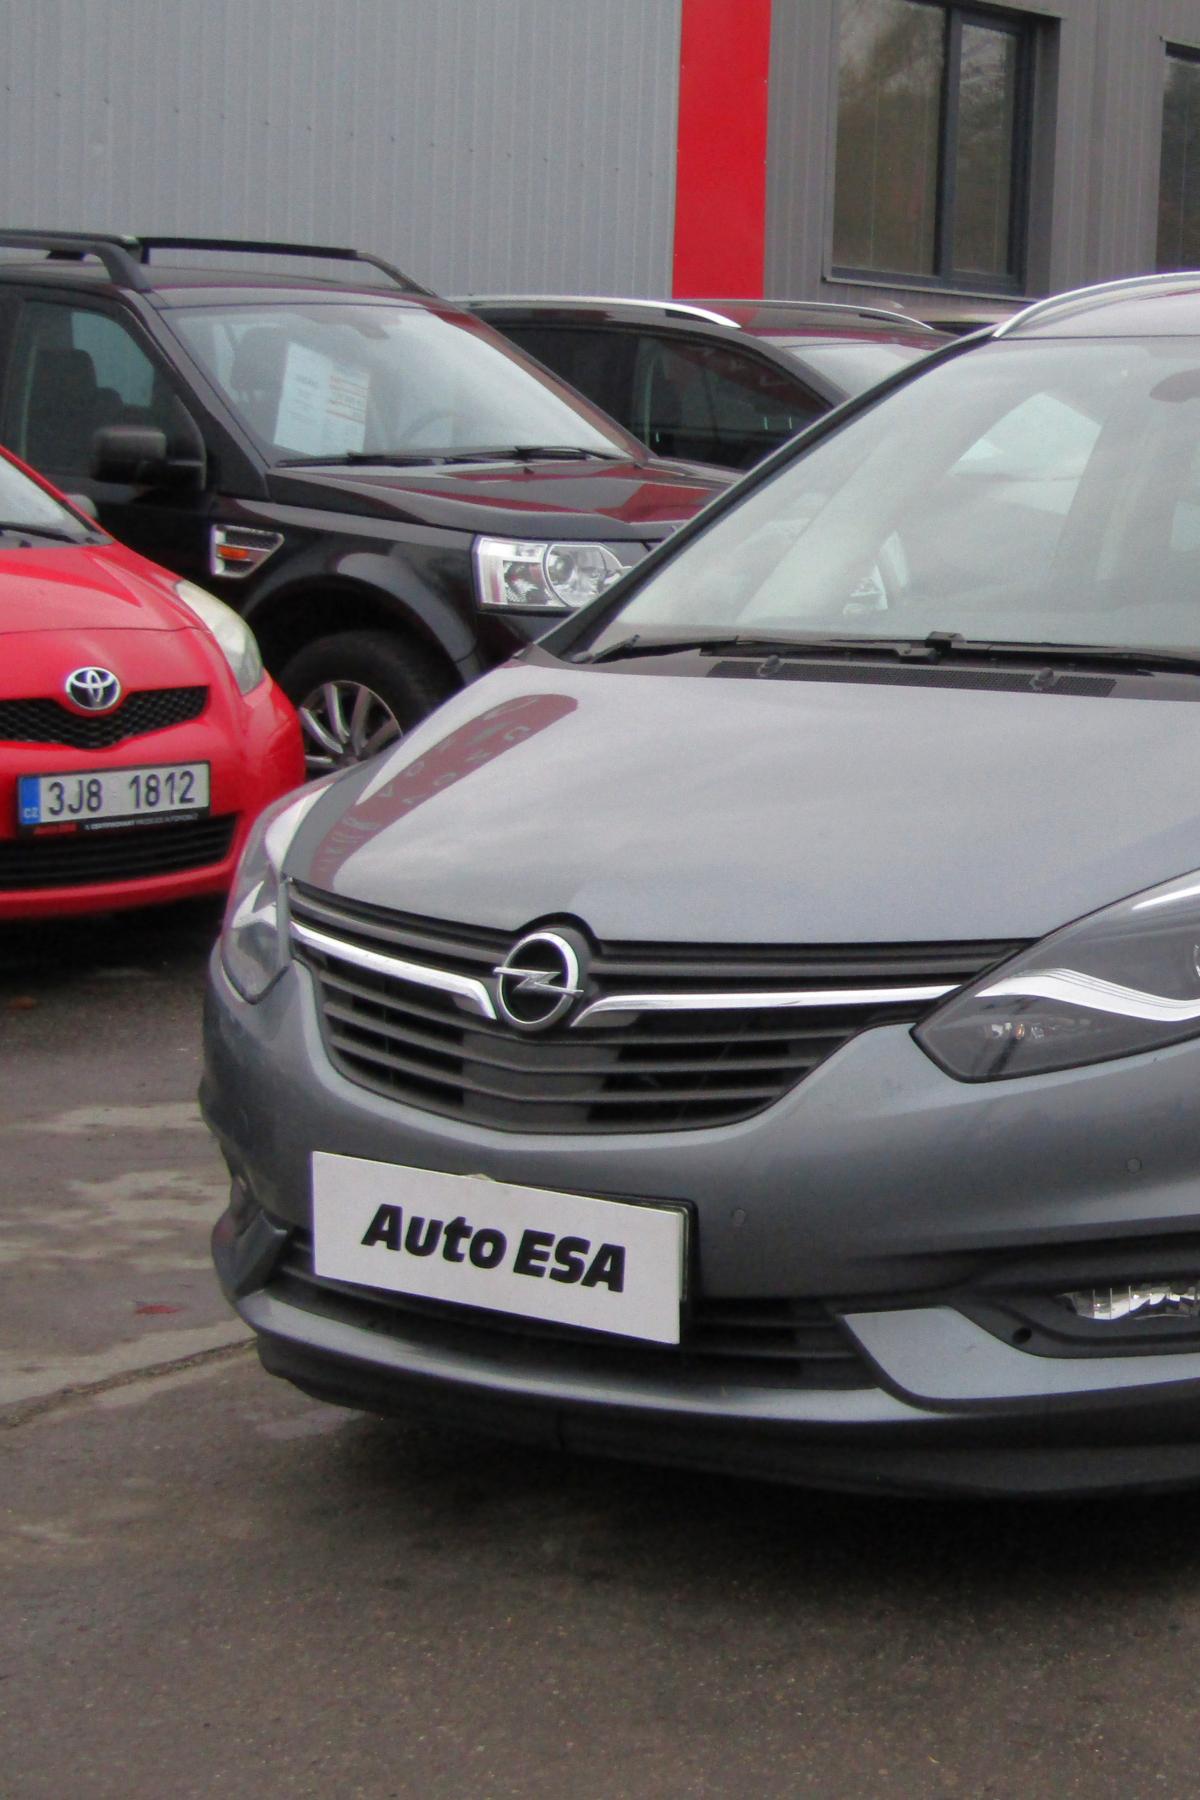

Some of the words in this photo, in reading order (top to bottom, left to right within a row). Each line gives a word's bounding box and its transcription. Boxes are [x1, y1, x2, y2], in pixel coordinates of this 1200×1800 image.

[23, 807, 40, 819] CZ
[48, 779, 103, 815] 3J8
[129, 769, 196, 810] 1812
[360, 1202, 508, 1270] Auto
[513, 1228, 626, 1293] ESA
